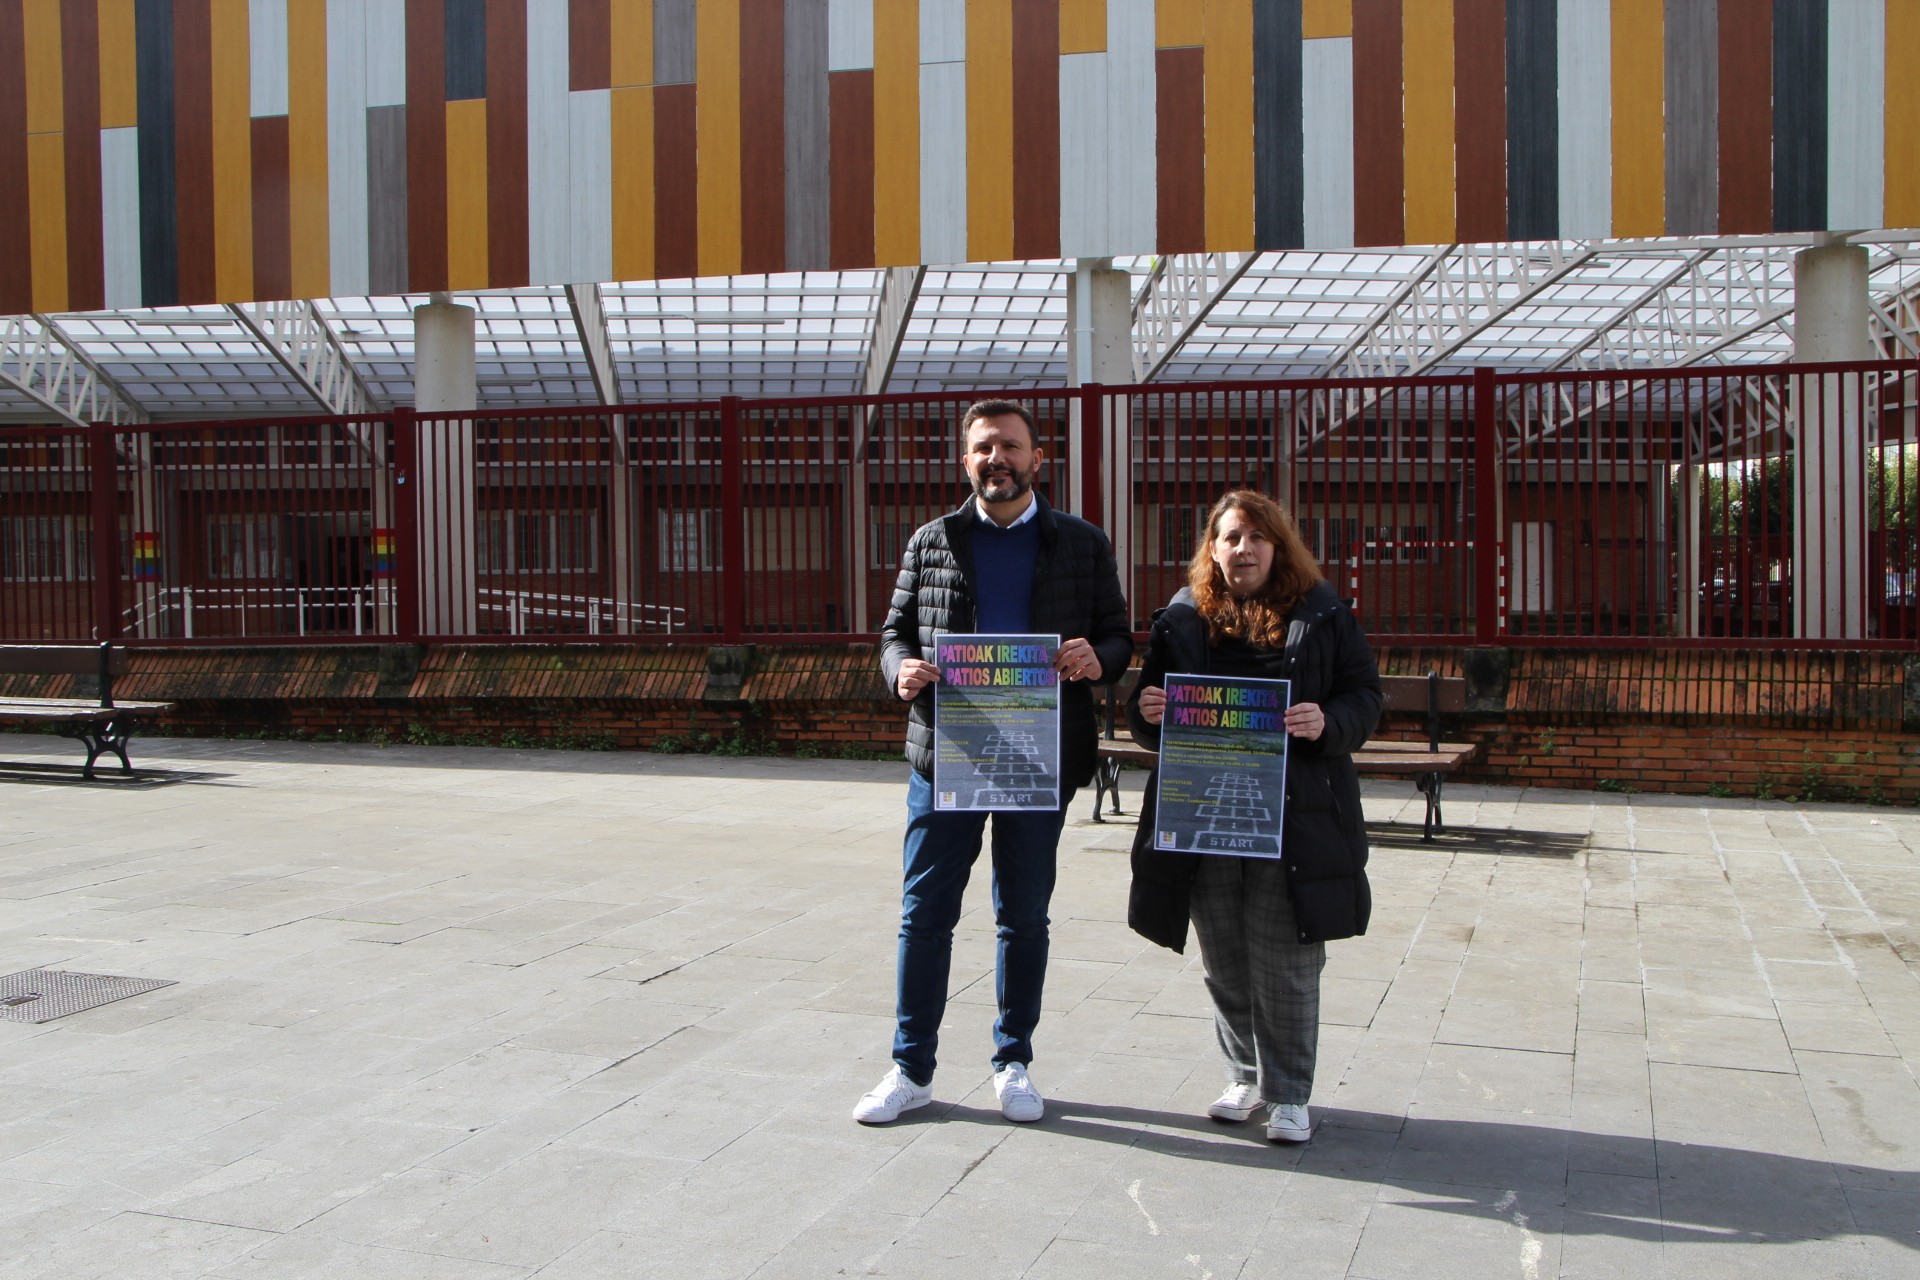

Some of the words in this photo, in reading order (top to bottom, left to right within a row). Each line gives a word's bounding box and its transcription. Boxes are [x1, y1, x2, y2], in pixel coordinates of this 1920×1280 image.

[940, 645, 993, 662] PATIOAK
[997, 645, 1048, 663] IREKITA
[946, 667, 990, 685] PATIOS
[993, 667, 1056, 686] ABIERTOS
[1168, 684, 1223, 704] PATIOAK
[1226, 688, 1278, 708] IREKITA
[1174, 707, 1217, 727] PATIOS
[1220, 710, 1284, 731] ABIERTOS
[989, 793, 1033, 803] START
[1209, 837, 1254, 848] START
